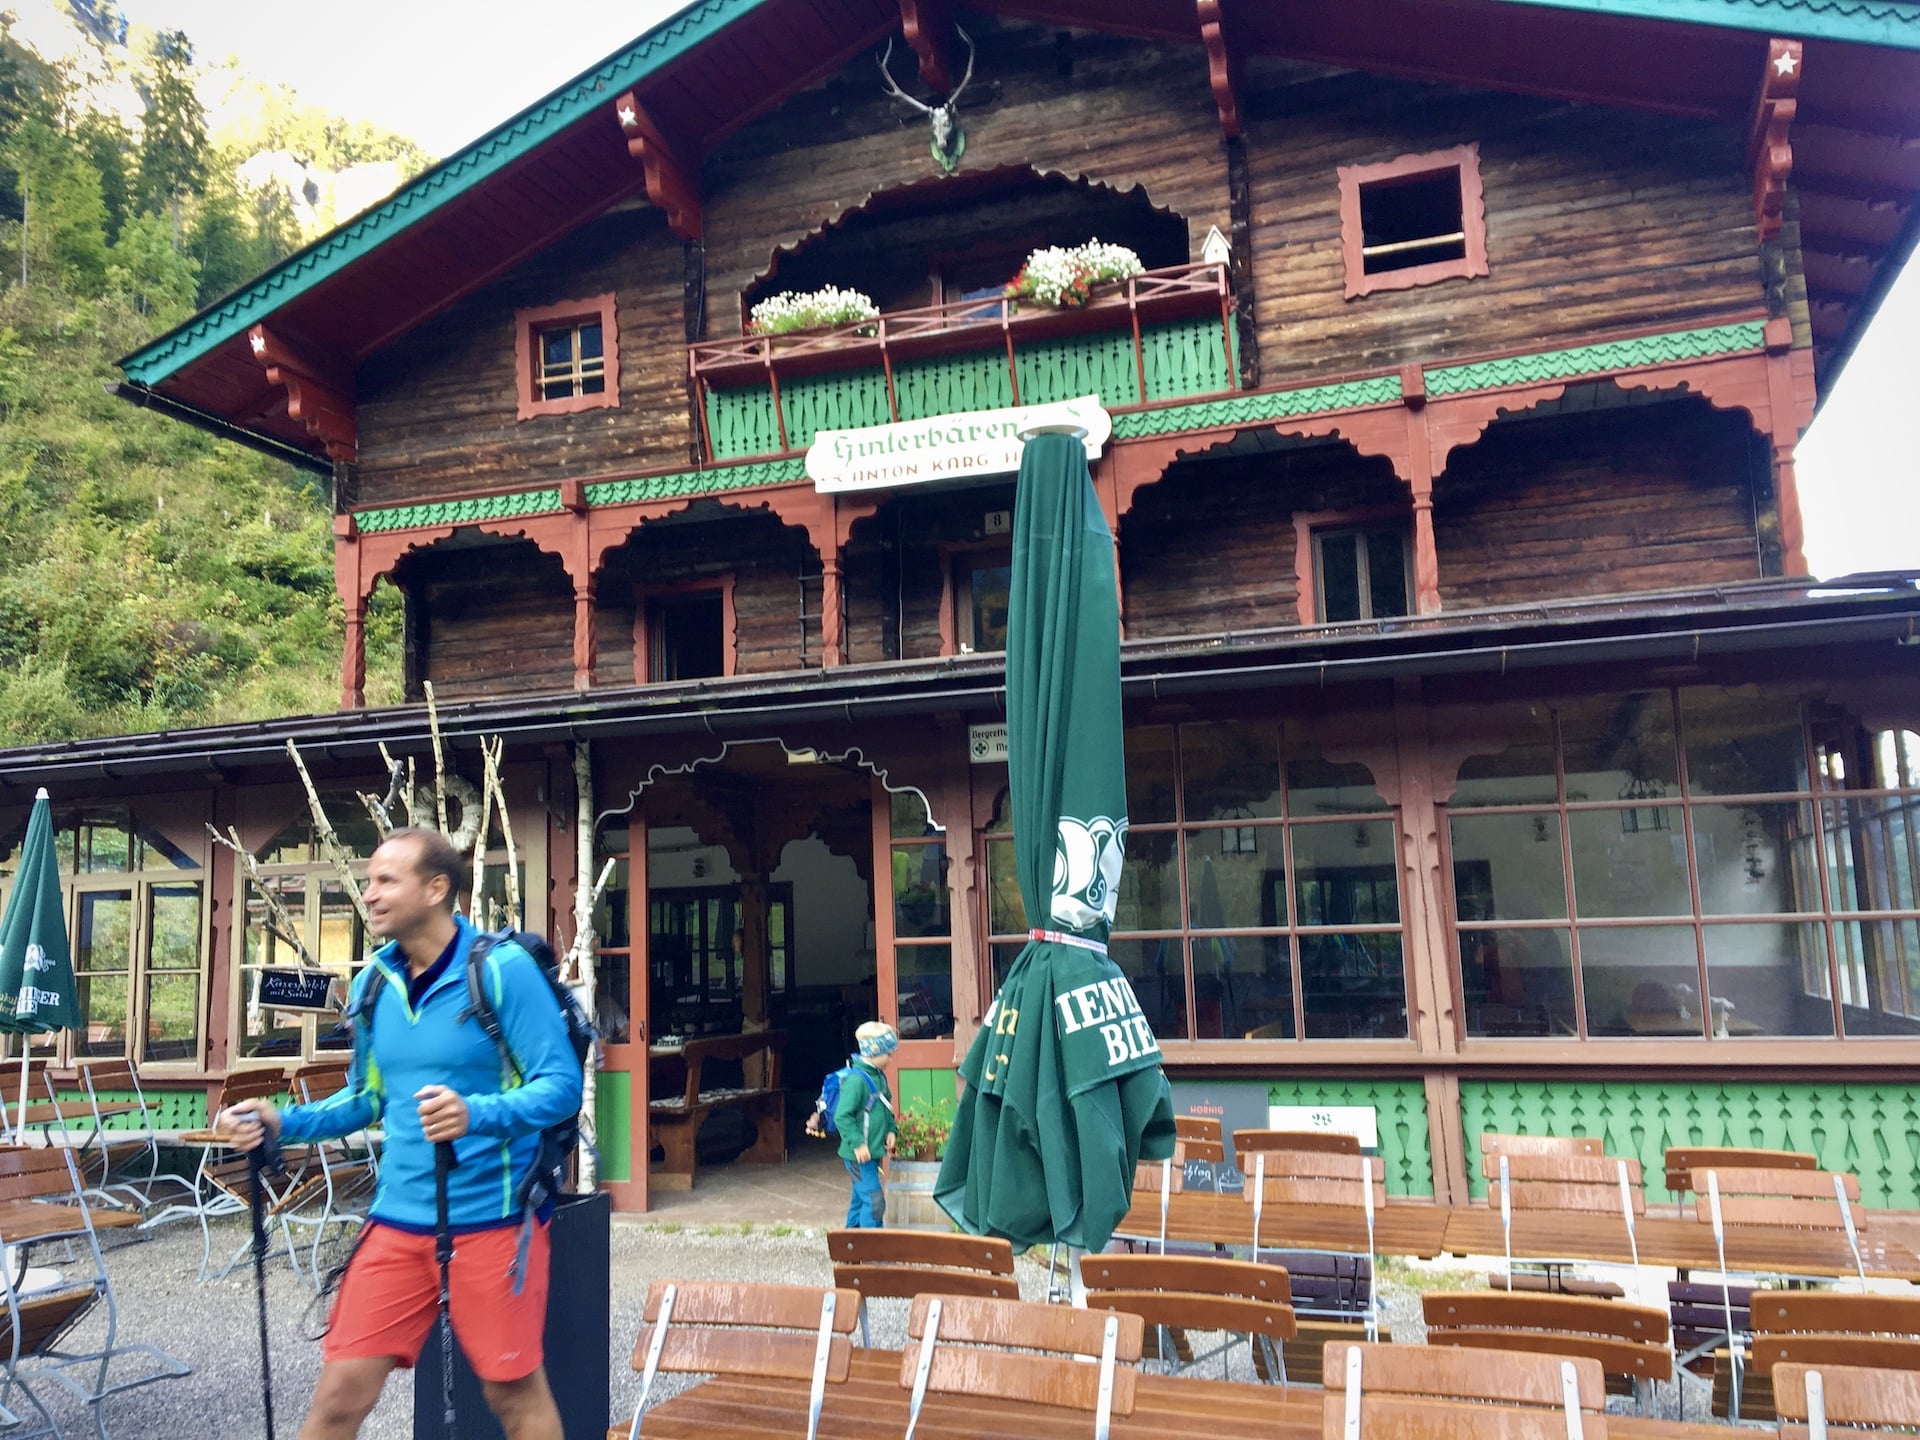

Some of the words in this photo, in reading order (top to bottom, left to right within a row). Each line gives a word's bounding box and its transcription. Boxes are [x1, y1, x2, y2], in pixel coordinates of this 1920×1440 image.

[833, 406, 1081, 468] Hinterbären
[852, 463, 919, 483] ANTON
[932, 453, 989, 472] KARG
[1099, 1015, 1160, 1066] BIE
